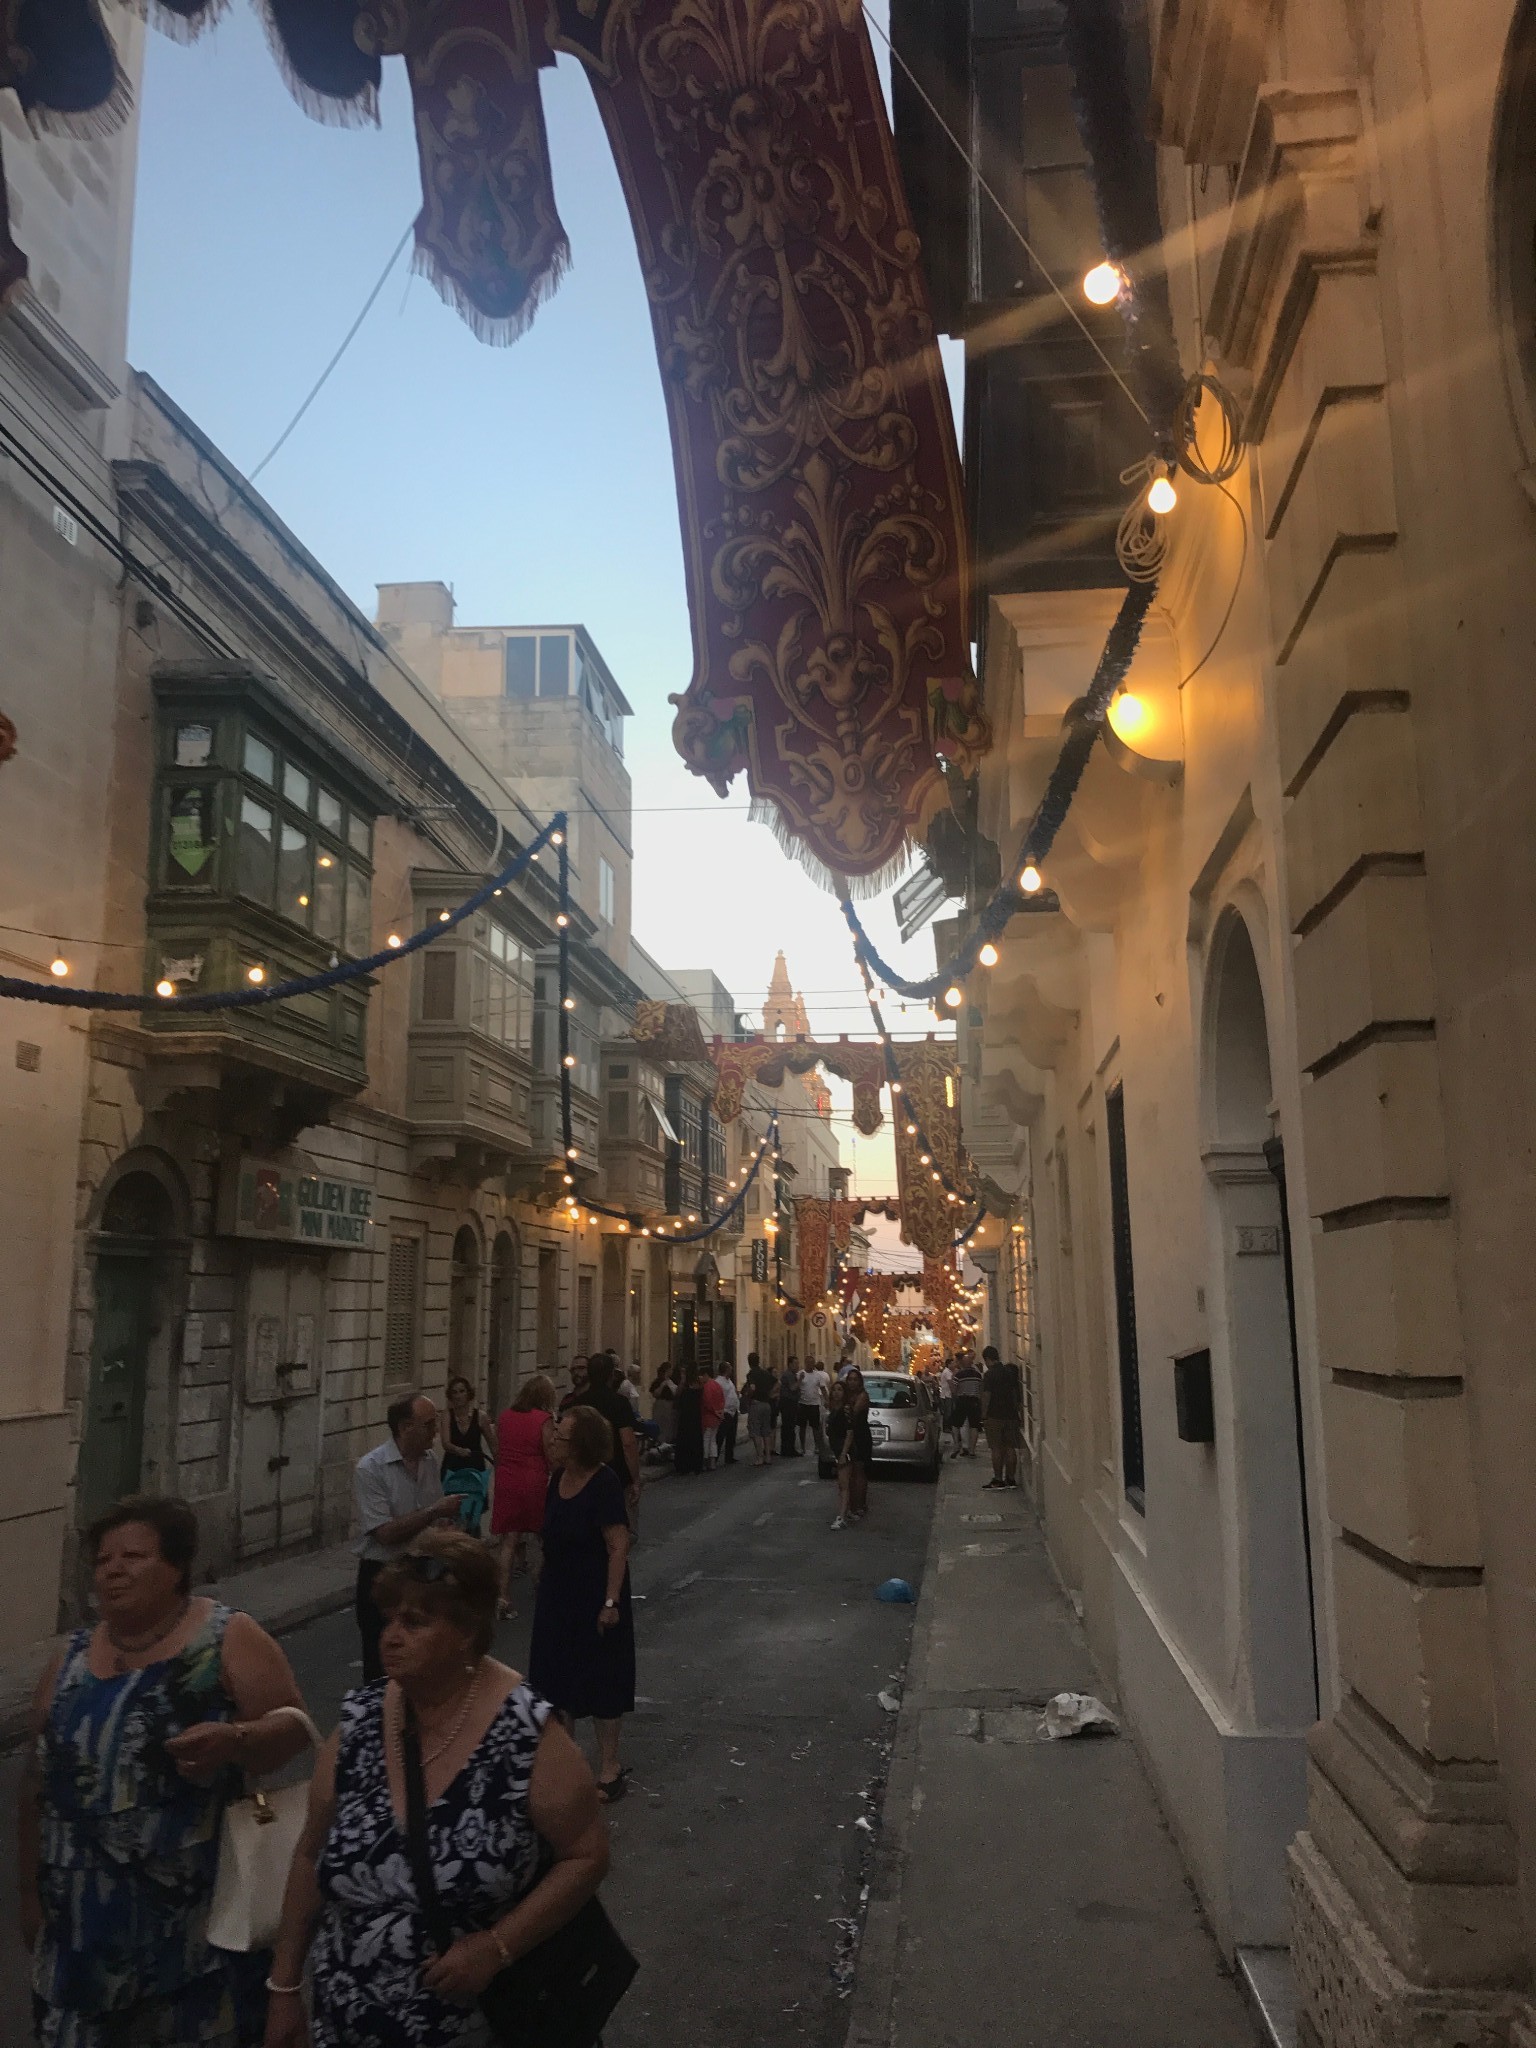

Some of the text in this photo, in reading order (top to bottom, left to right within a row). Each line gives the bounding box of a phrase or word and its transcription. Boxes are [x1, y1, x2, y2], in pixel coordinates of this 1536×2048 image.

[299, 1176, 372, 1217] GOLDEN BEE
[301, 1209, 367, 1243] MINI MARKET
[755, 1239, 765, 1281] SPOONS
